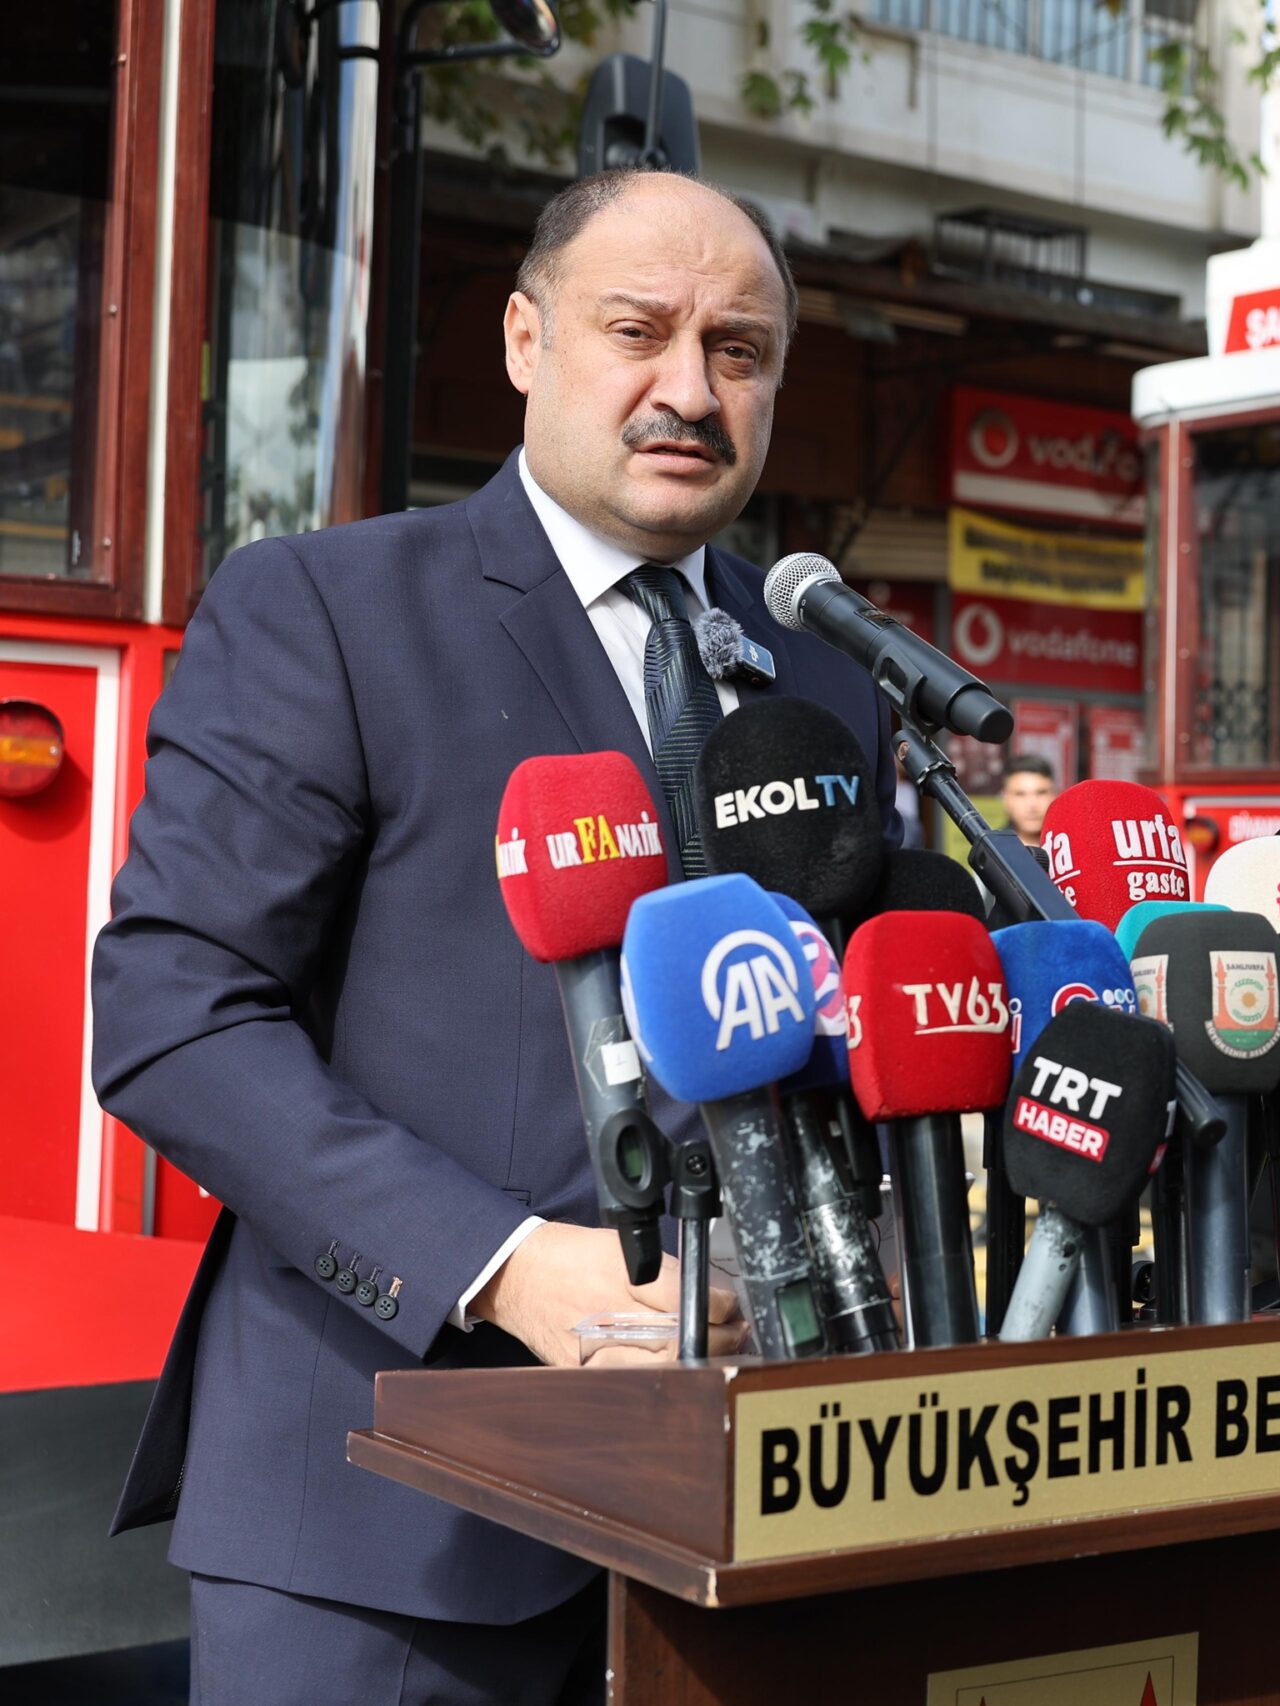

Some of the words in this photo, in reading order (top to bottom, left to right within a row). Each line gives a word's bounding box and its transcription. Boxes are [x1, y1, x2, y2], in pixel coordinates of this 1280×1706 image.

[1111, 814, 1186, 865] urfa
[1127, 869, 1185, 901] gaste
[716, 953, 806, 1051] AA
[902, 975, 1009, 1034] TV63
[1030, 1056, 1123, 1120] TRT
[1017, 1102, 1104, 1157] HABER
[760, 1366, 1193, 1516] BÜYÜKŞEHİR
